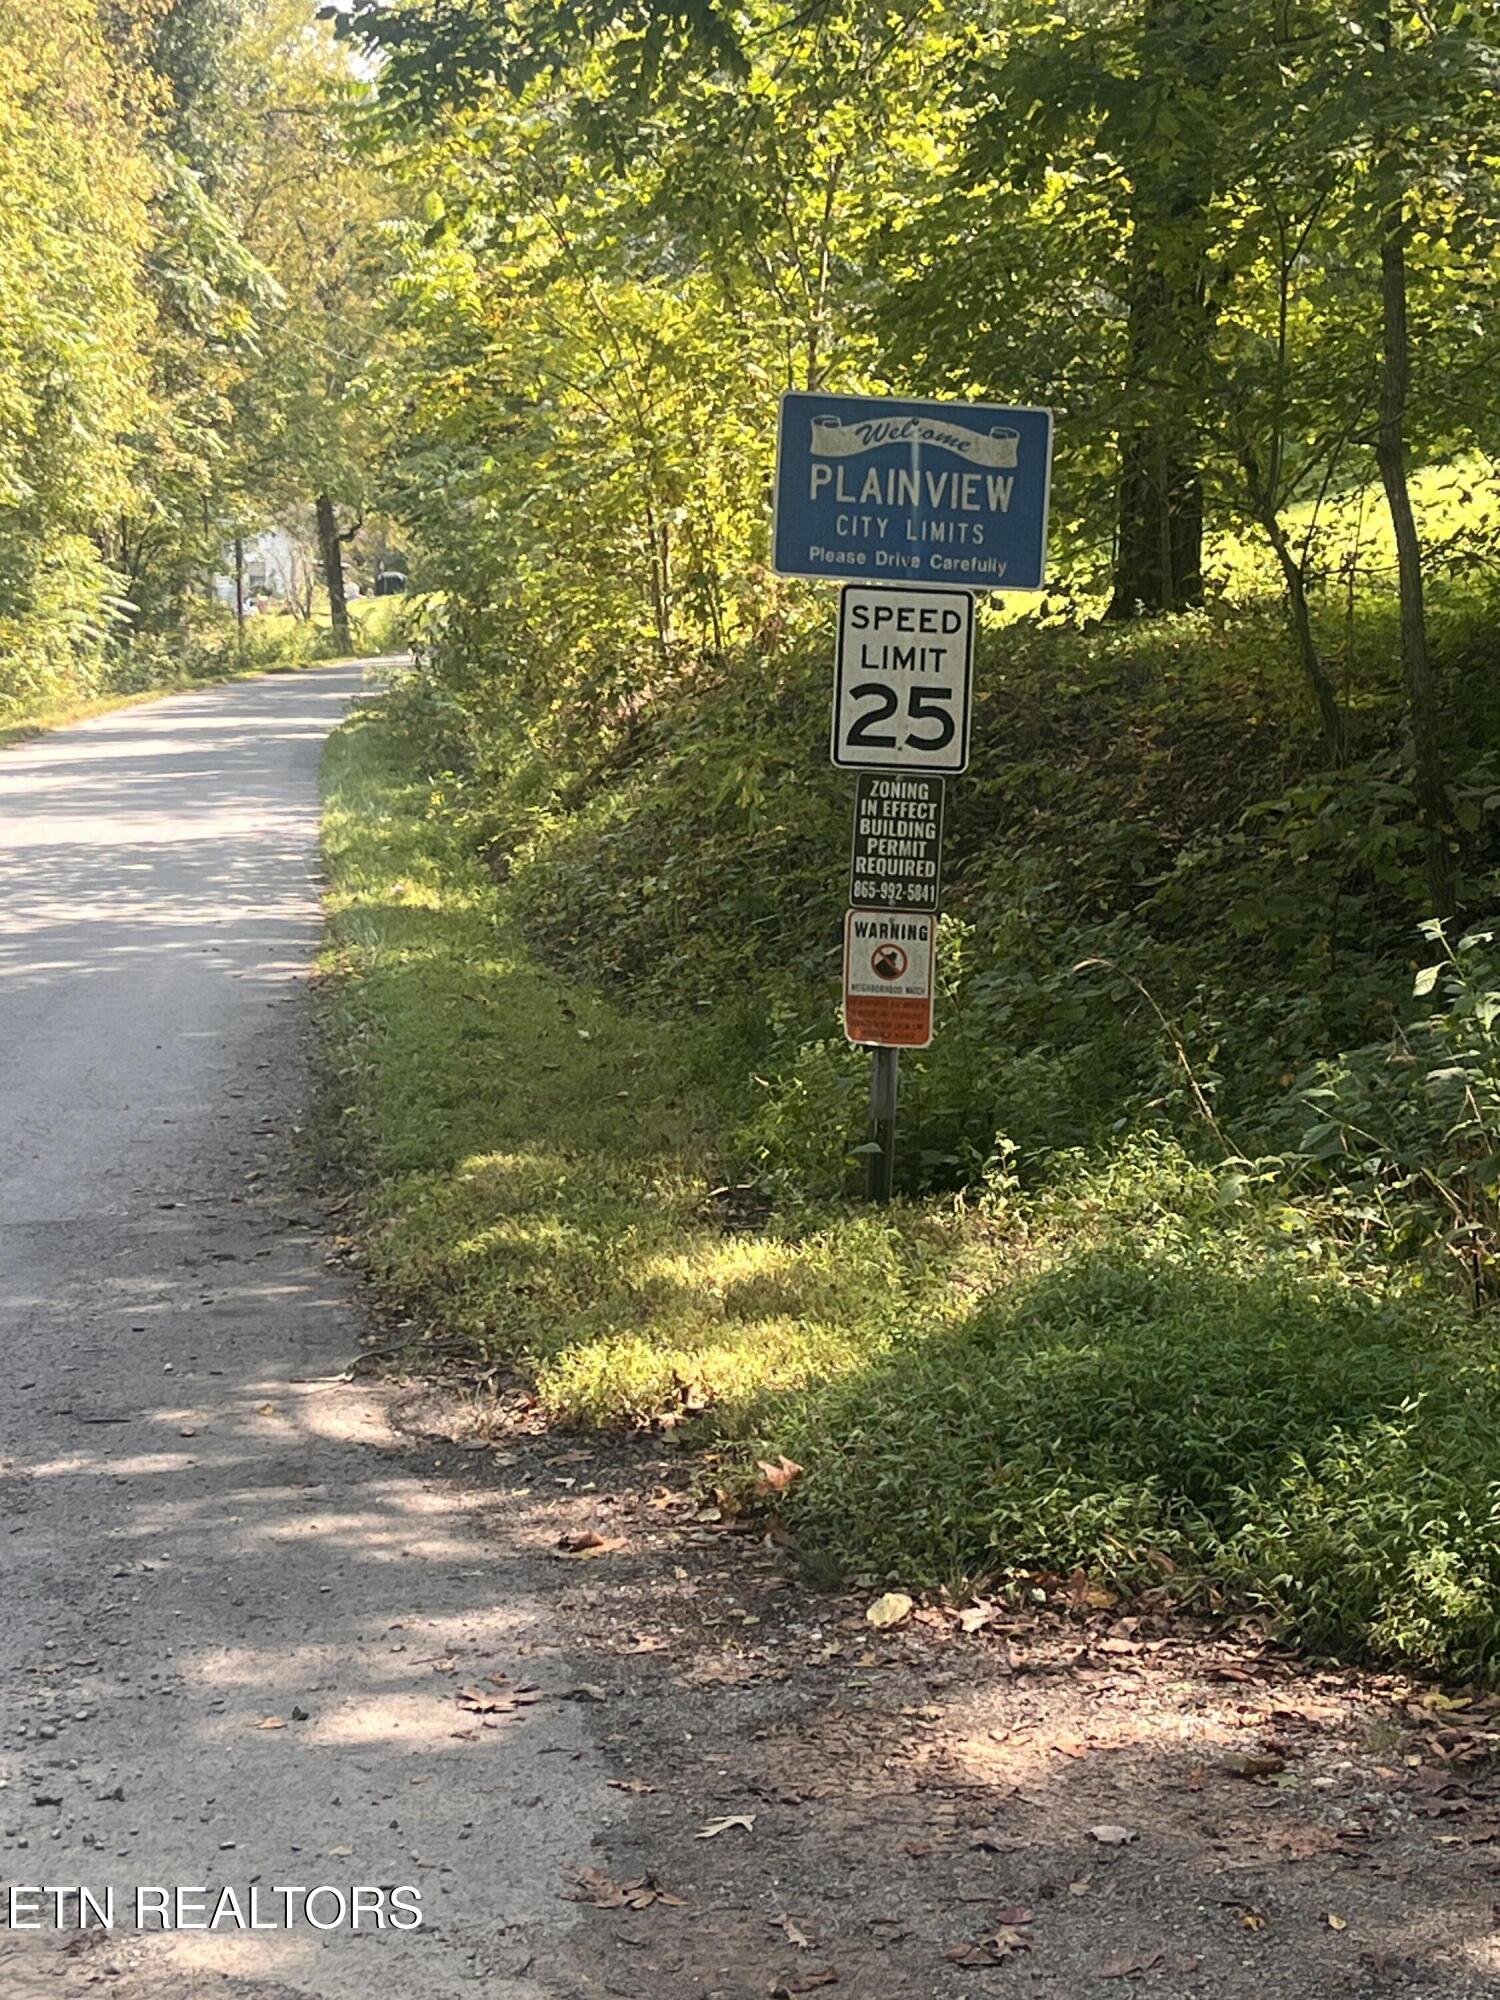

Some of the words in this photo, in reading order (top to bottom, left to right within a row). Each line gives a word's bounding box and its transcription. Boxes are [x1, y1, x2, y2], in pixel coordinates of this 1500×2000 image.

[810, 464, 1014, 513] PLAINVIEW
[836, 514, 888, 538] CITY
[906, 519, 985, 545] LIMITS
[809, 546, 866, 565] Please
[875, 551, 921, 569] Drive
[930, 554, 1007, 577] Carefully
[851, 605, 962, 634] SPEED
[861, 644, 947, 672] LIMIT
[846, 683, 955, 752] 25
[870, 780, 929, 800] ZONING
[861, 799, 878, 816] IN
[882, 801, 937, 820] EFFECT
[860, 818, 936, 840] BUILDING
[867, 838, 927, 858] PERMIT
[855, 856, 935, 877] REQUIRED
[853, 880, 935, 902] 865-992-5841
[854, 921, 928, 941] WARNING
